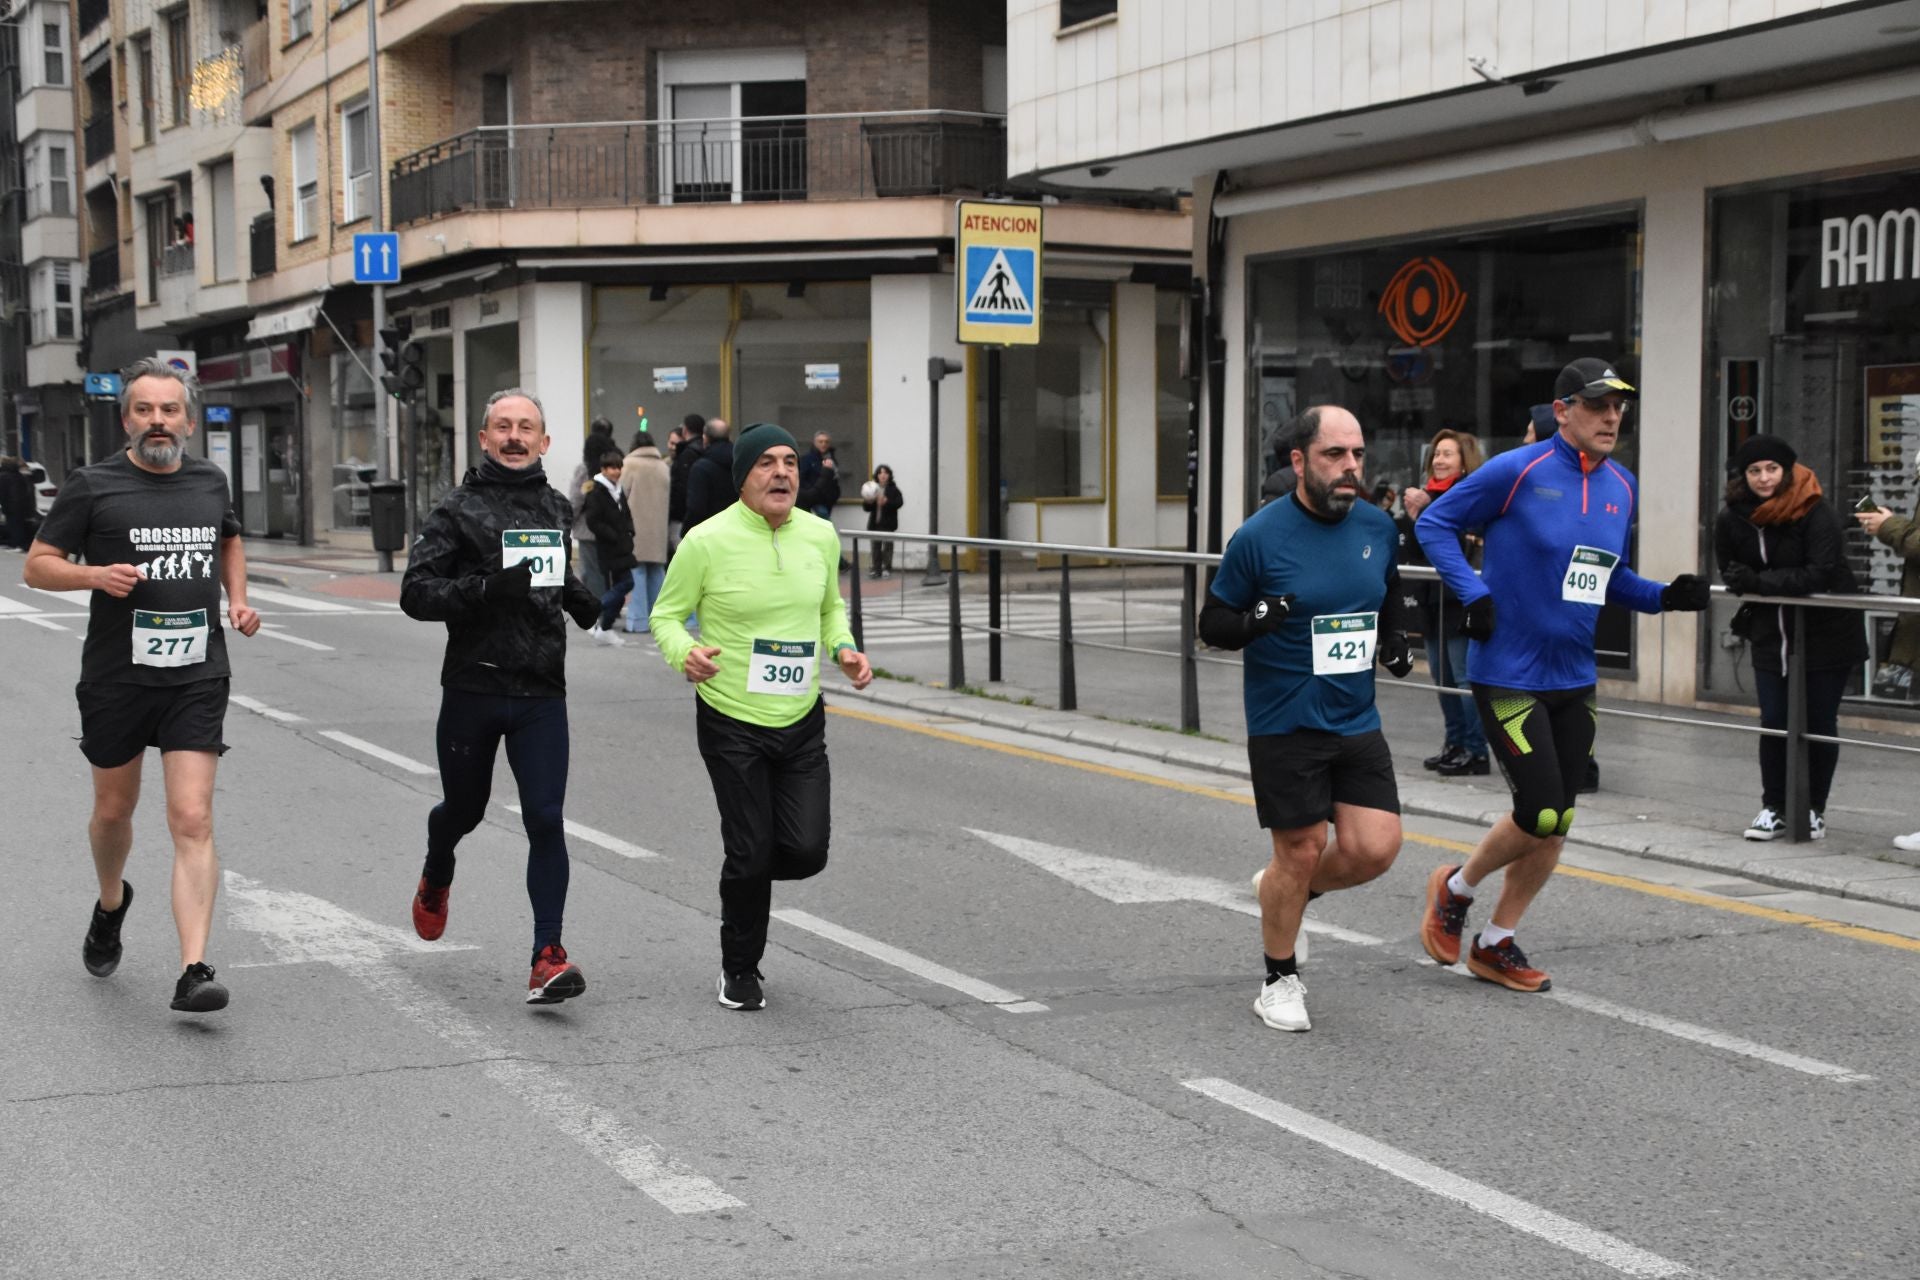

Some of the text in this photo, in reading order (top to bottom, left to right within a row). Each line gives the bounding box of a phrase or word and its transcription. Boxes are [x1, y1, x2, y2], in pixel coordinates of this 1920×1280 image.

[964, 215, 1037, 232] ATENCION
[129, 527, 216, 544] CROSSBROS
[185, 543, 212, 551] MASTERS
[1568, 571, 1597, 590] 409
[147, 637, 194, 655] 277
[1328, 640, 1366, 660] 421
[762, 664, 804, 683] 390
